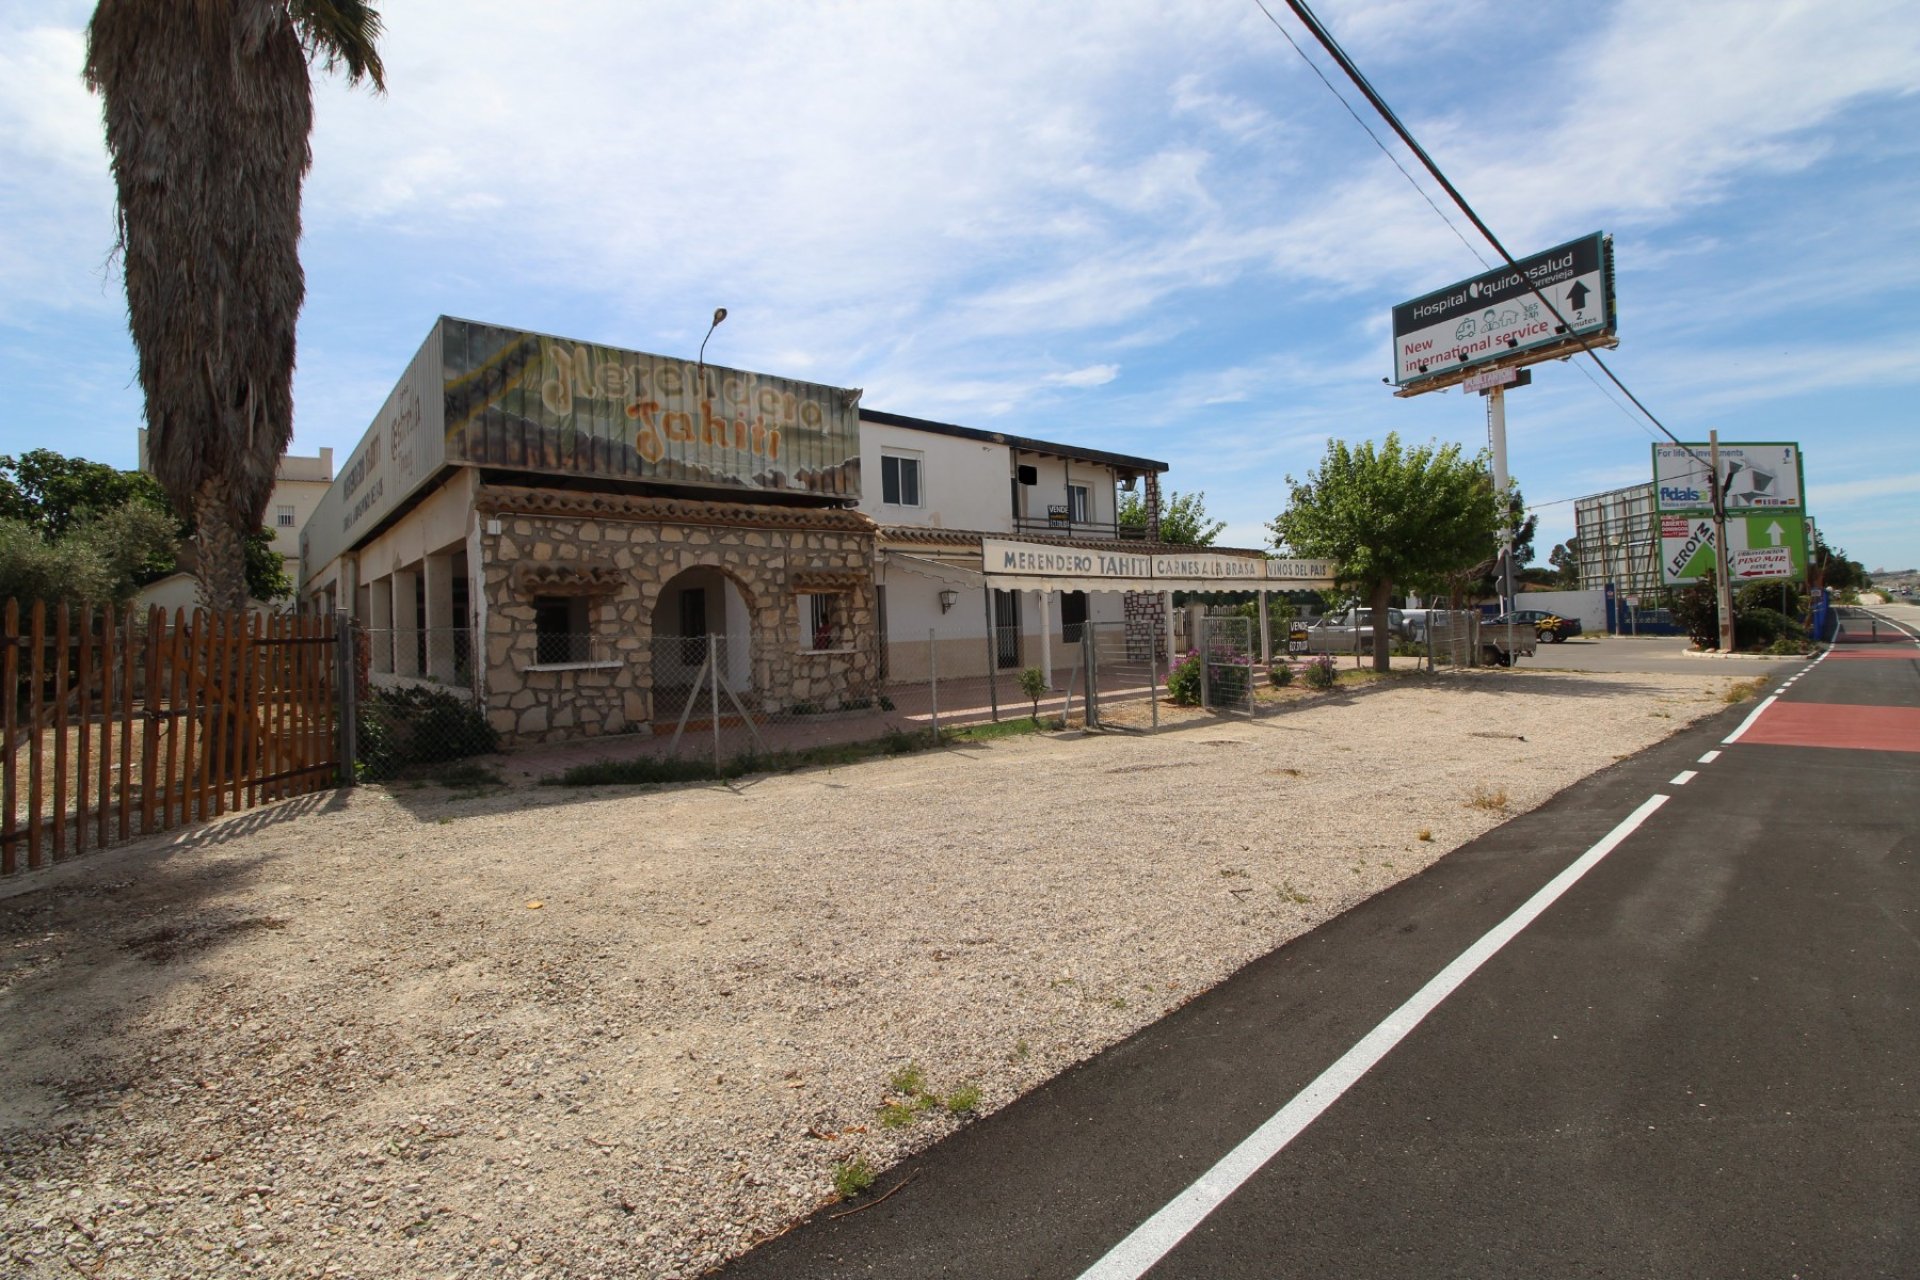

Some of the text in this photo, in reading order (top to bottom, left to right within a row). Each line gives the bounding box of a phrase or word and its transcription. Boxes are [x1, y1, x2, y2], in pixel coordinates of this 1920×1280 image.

[1528, 268, 1574, 290] orrevieja
[1414, 290, 1468, 320] Hospital
[1566, 316, 1598, 330] inutes
[1576, 311, 1584, 321] 2
[1405, 320, 1549, 372] international service
[1405, 338, 1434, 355] New
[541, 345, 823, 430] Merendero
[1657, 449, 1671, 458] For
[1673, 449, 1685, 458] life
[1004, 551, 1150, 577] MERENDERO TAHITI
[1667, 532, 1703, 578] LEROY
[1157, 560, 1256, 576] CARNES A LA BRASA
[1267, 563, 1293, 577] VINOS
[1294, 564, 1308, 577] DEL
